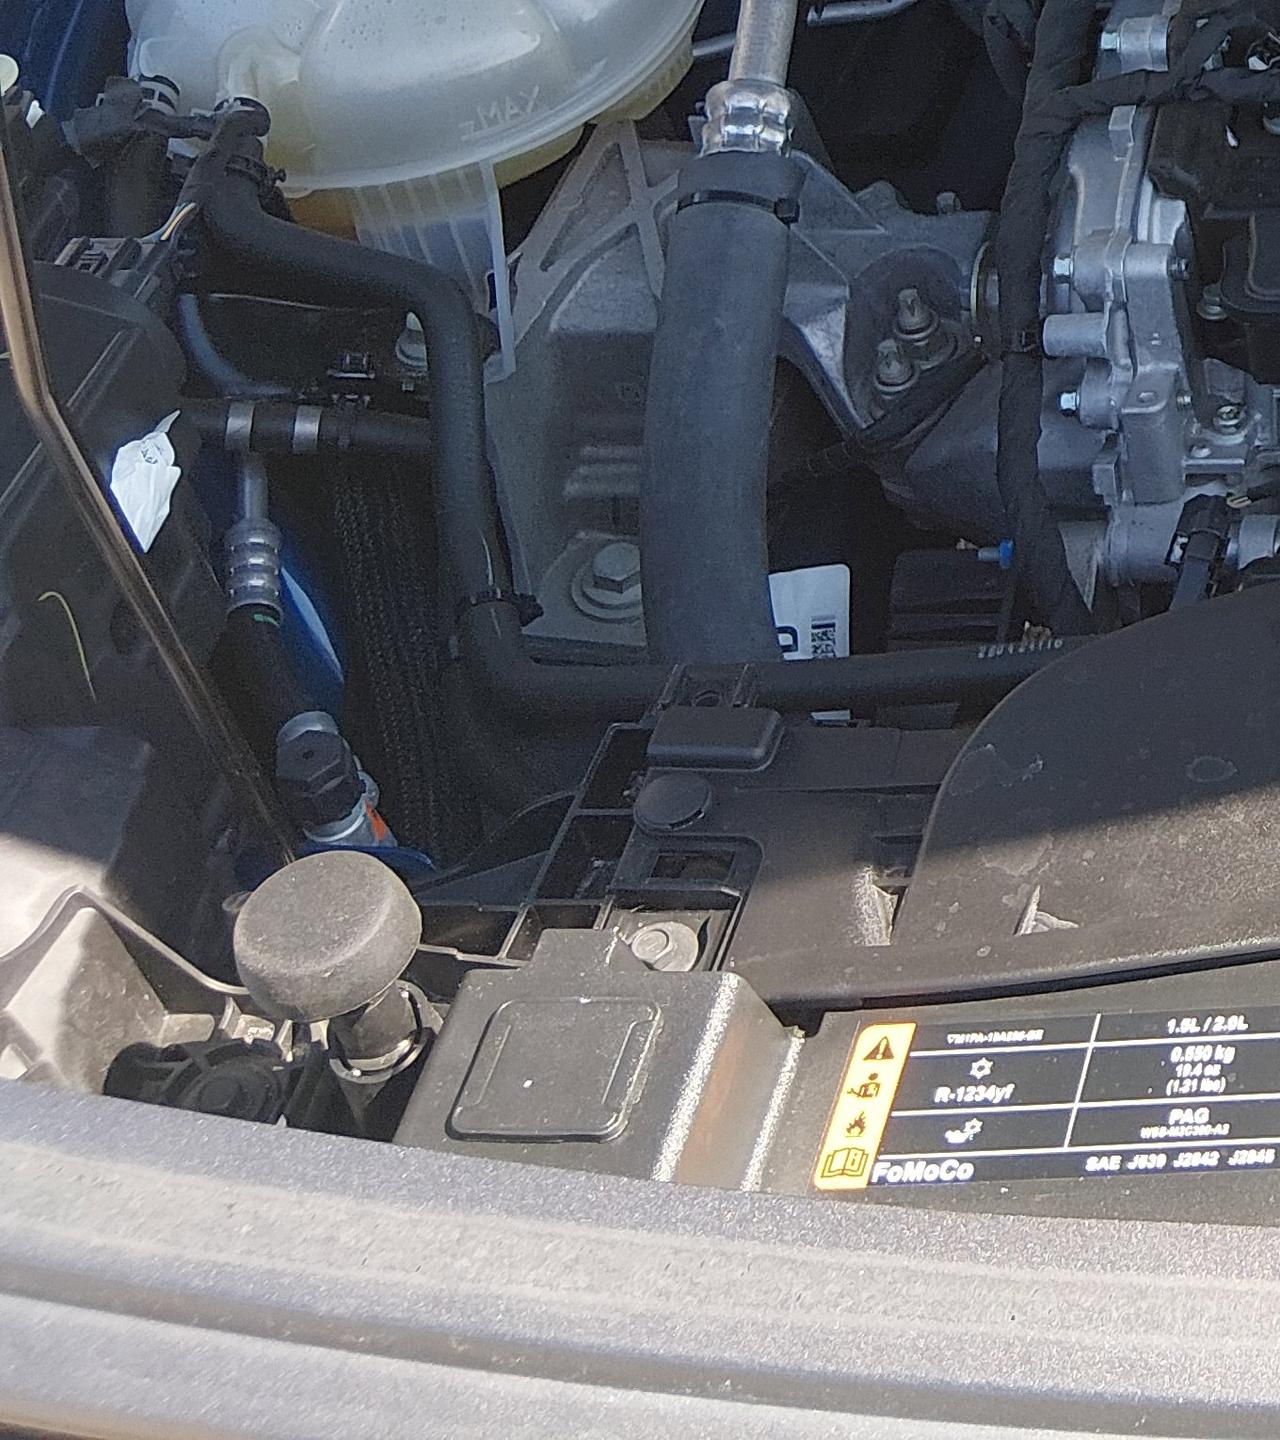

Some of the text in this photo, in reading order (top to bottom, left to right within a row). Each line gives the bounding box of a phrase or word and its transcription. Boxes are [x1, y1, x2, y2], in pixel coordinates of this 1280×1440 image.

[934, 1083, 1016, 1103] R-1234yf
[1168, 1107, 1210, 1125] PAG
[871, 1159, 975, 1183] FoMoCo
[1085, 1155, 1122, 1172] SAE
